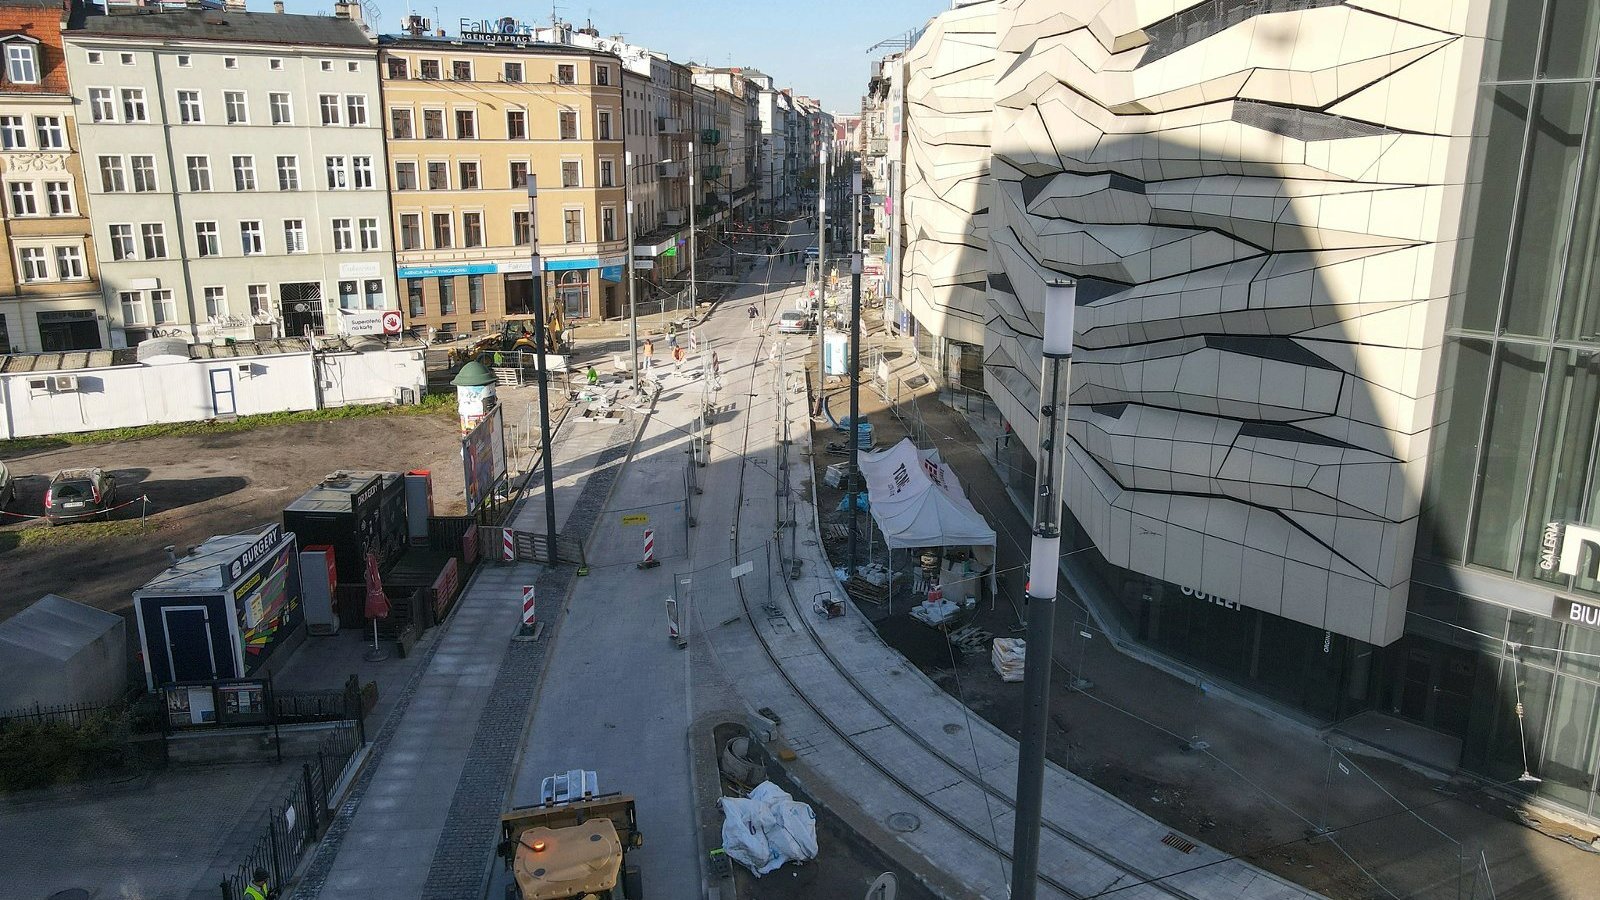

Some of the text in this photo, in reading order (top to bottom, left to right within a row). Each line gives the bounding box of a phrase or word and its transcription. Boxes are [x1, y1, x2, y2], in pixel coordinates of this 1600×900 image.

[461, 33, 503, 41] AGENCJA
[242, 528, 278, 567] BURGERY
[1540, 522, 1559, 570] GALERIA
[1570, 602, 1600, 627] BIU
